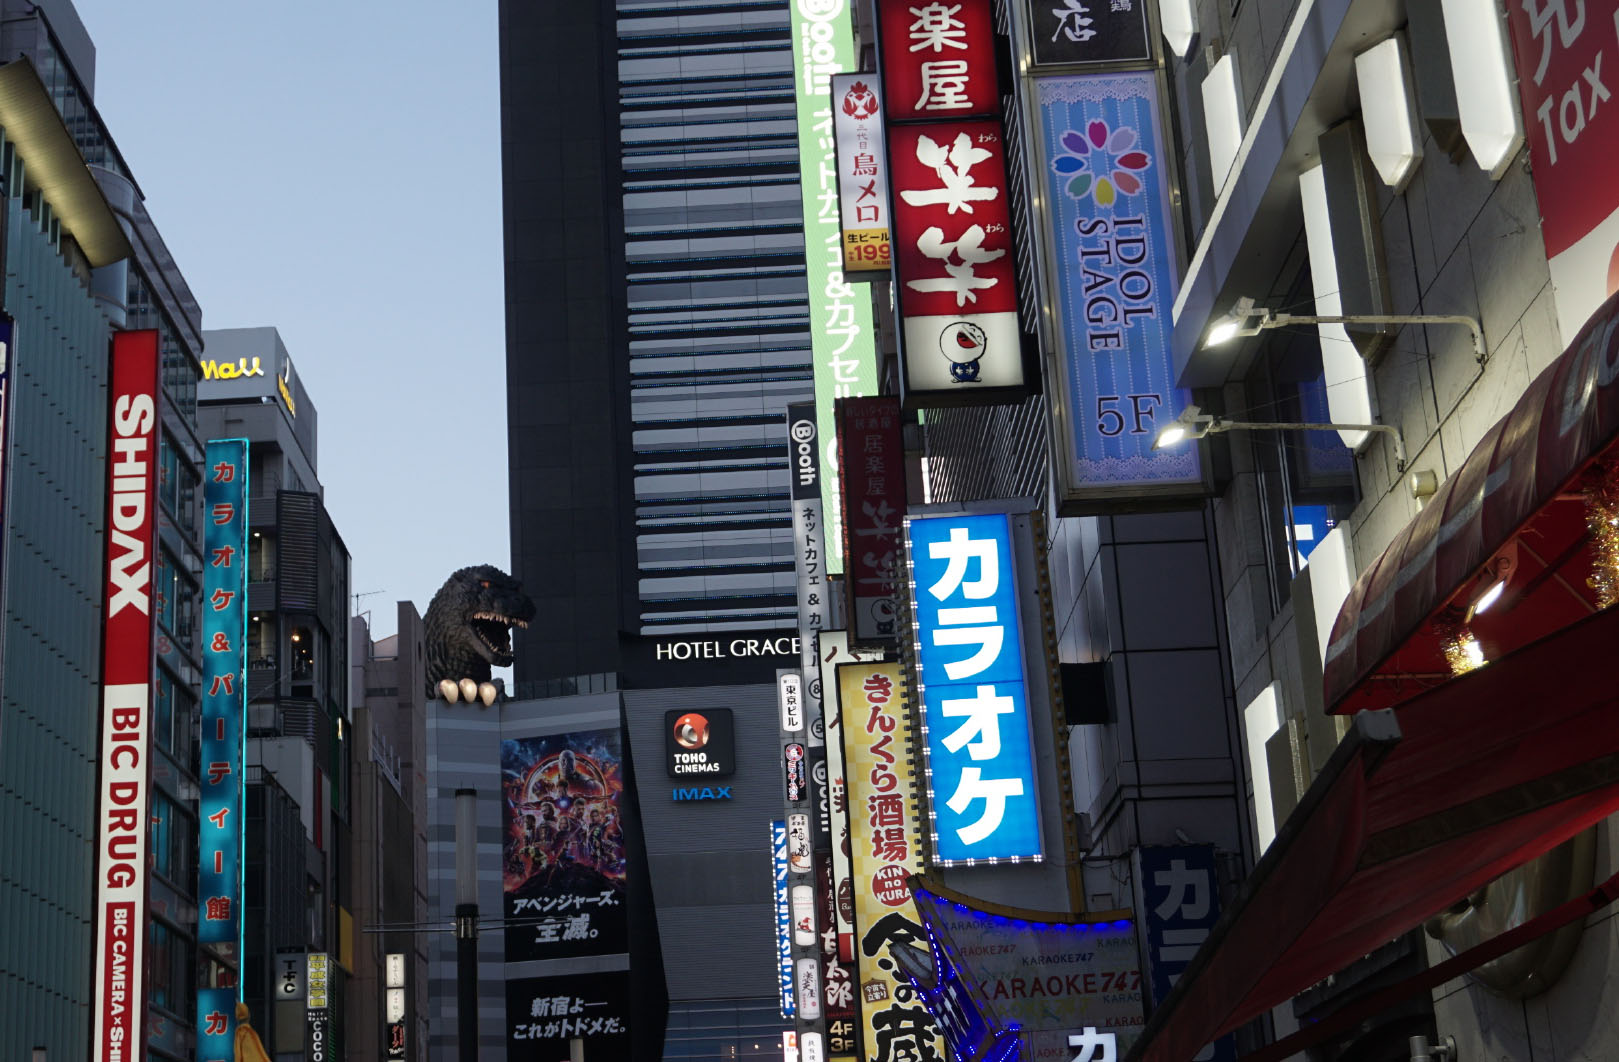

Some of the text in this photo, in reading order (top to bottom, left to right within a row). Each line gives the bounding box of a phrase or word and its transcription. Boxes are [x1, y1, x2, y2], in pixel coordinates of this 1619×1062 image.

[909, 1, 974, 111] 楽屋
[1537, 49, 1612, 167] Tax
[852, 152, 880, 224] 鳥メロ
[1077, 218, 1122, 351] STAGE
[1113, 216, 1154, 327] IDOL
[1097, 394, 1162, 437] 5F
[791, 419, 817, 487] Booth
[863, 434, 887, 496] 居楽屋
[109, 393, 155, 619] SHIDAX
[802, 508, 820, 586] ネットカフェ
[807, 593, 820, 606] &
[656, 641, 727, 661] HOTEL
[205, 461, 236, 921] カラオケ&パーティー館
[928, 527, 1025, 846] カラオケ
[785, 685, 799, 727] 東京ビル
[674, 752, 708, 764] TOHO
[674, 763, 721, 774] CINEMAS
[863, 673, 909, 862] きんくら酒場
[106, 707, 141, 889] BIC DRUG
[672, 786, 733, 801] IMAX
[877, 866, 904, 881] KIN
[884, 878, 902, 889] no
[513, 889, 620, 915] アベンジャーズ、
[877, 886, 912, 902] KURA
[113, 907, 127, 937] BIC
[535, 913, 599, 943] 全滅。
[1022, 952, 1095, 967] KARAOKE747
[513, 1017, 626, 1040] これがトドメだ。
[829, 1020, 853, 1036] 4F
[830, 1037, 854, 1053] 3F
